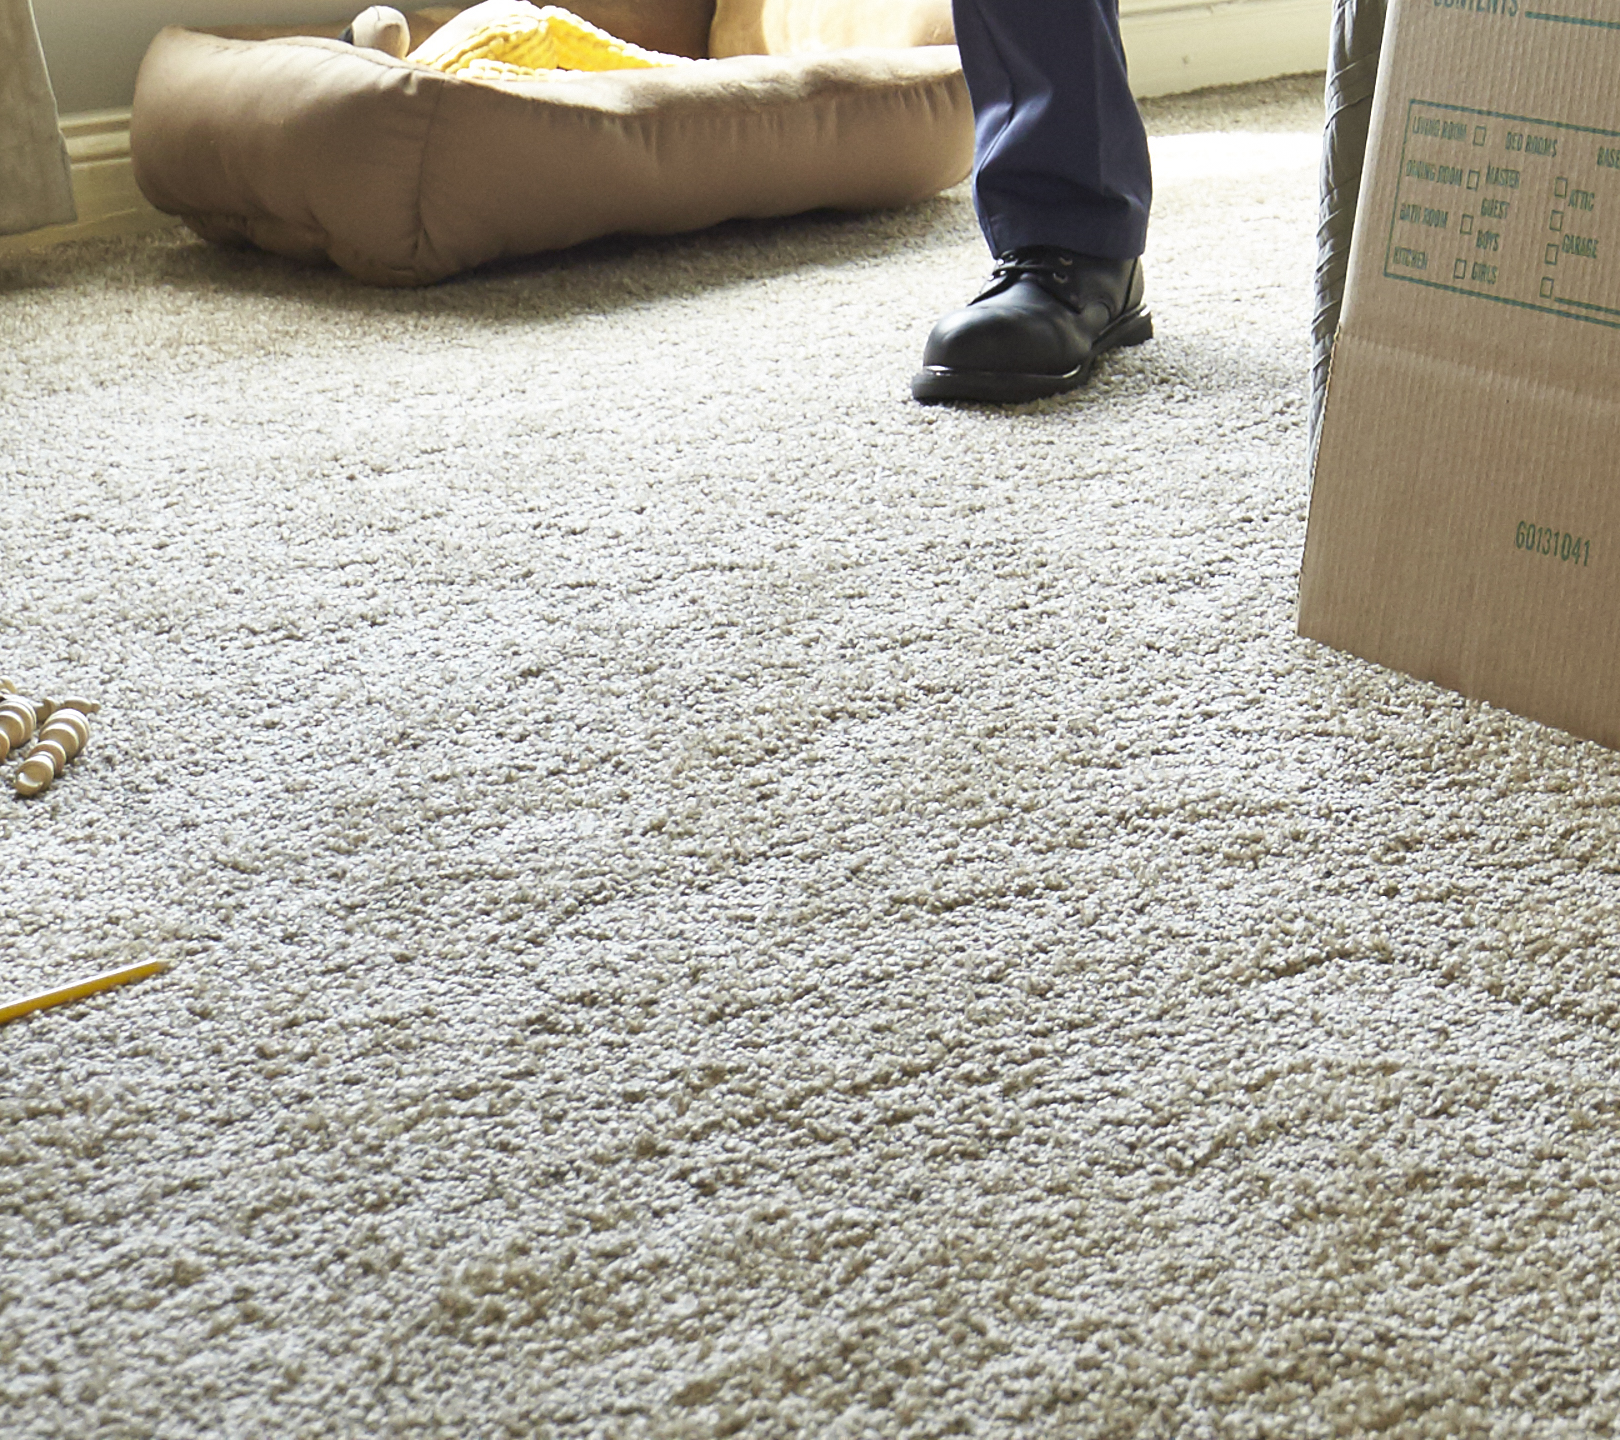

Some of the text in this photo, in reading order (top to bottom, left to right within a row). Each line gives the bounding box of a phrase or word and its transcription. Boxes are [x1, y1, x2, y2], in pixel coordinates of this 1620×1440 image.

[1412, 116, 1467, 142] LIVING ROOM
[1525, 134, 1558, 158] ROOMS
[1436, 165, 1463, 187] ROOM
[1485, 164, 1520, 189] MASTER
[1481, 198, 1510, 220] GUEST
[1568, 189, 1595, 211] ATTIC
[1422, 207, 1448, 228] ROOM
[1475, 230, 1500, 252] BOYS
[1561, 234, 1599, 258] GARAGE
[1392, 246, 1428, 270] KITCHEN
[1471, 262, 1498, 284] GIRLS
[1516, 520, 1590, 566] 60131041
